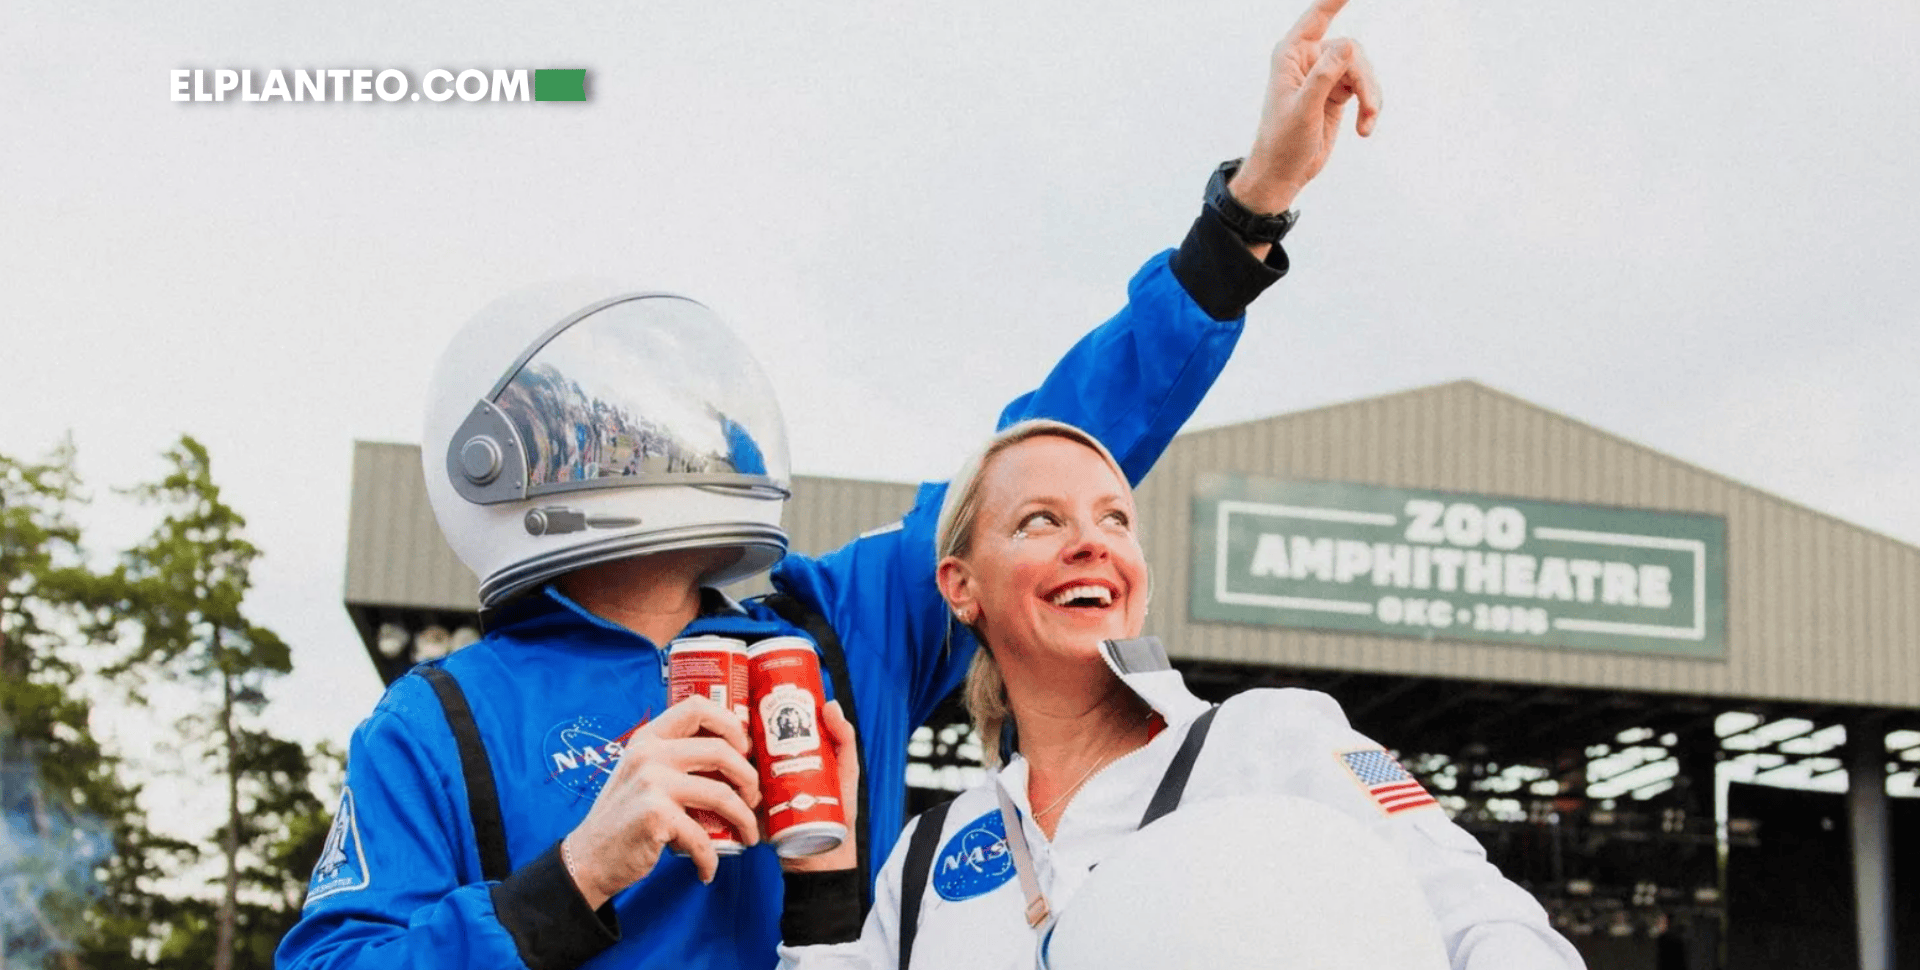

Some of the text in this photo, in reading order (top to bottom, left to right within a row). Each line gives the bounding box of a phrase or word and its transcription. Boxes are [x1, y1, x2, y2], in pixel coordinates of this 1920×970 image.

[1404, 499, 1526, 550] ZOO
[1250, 533, 1673, 608] AMPHITHEATRE
[551, 742, 625, 773] NAS
[942, 840, 1007, 876] NAS
